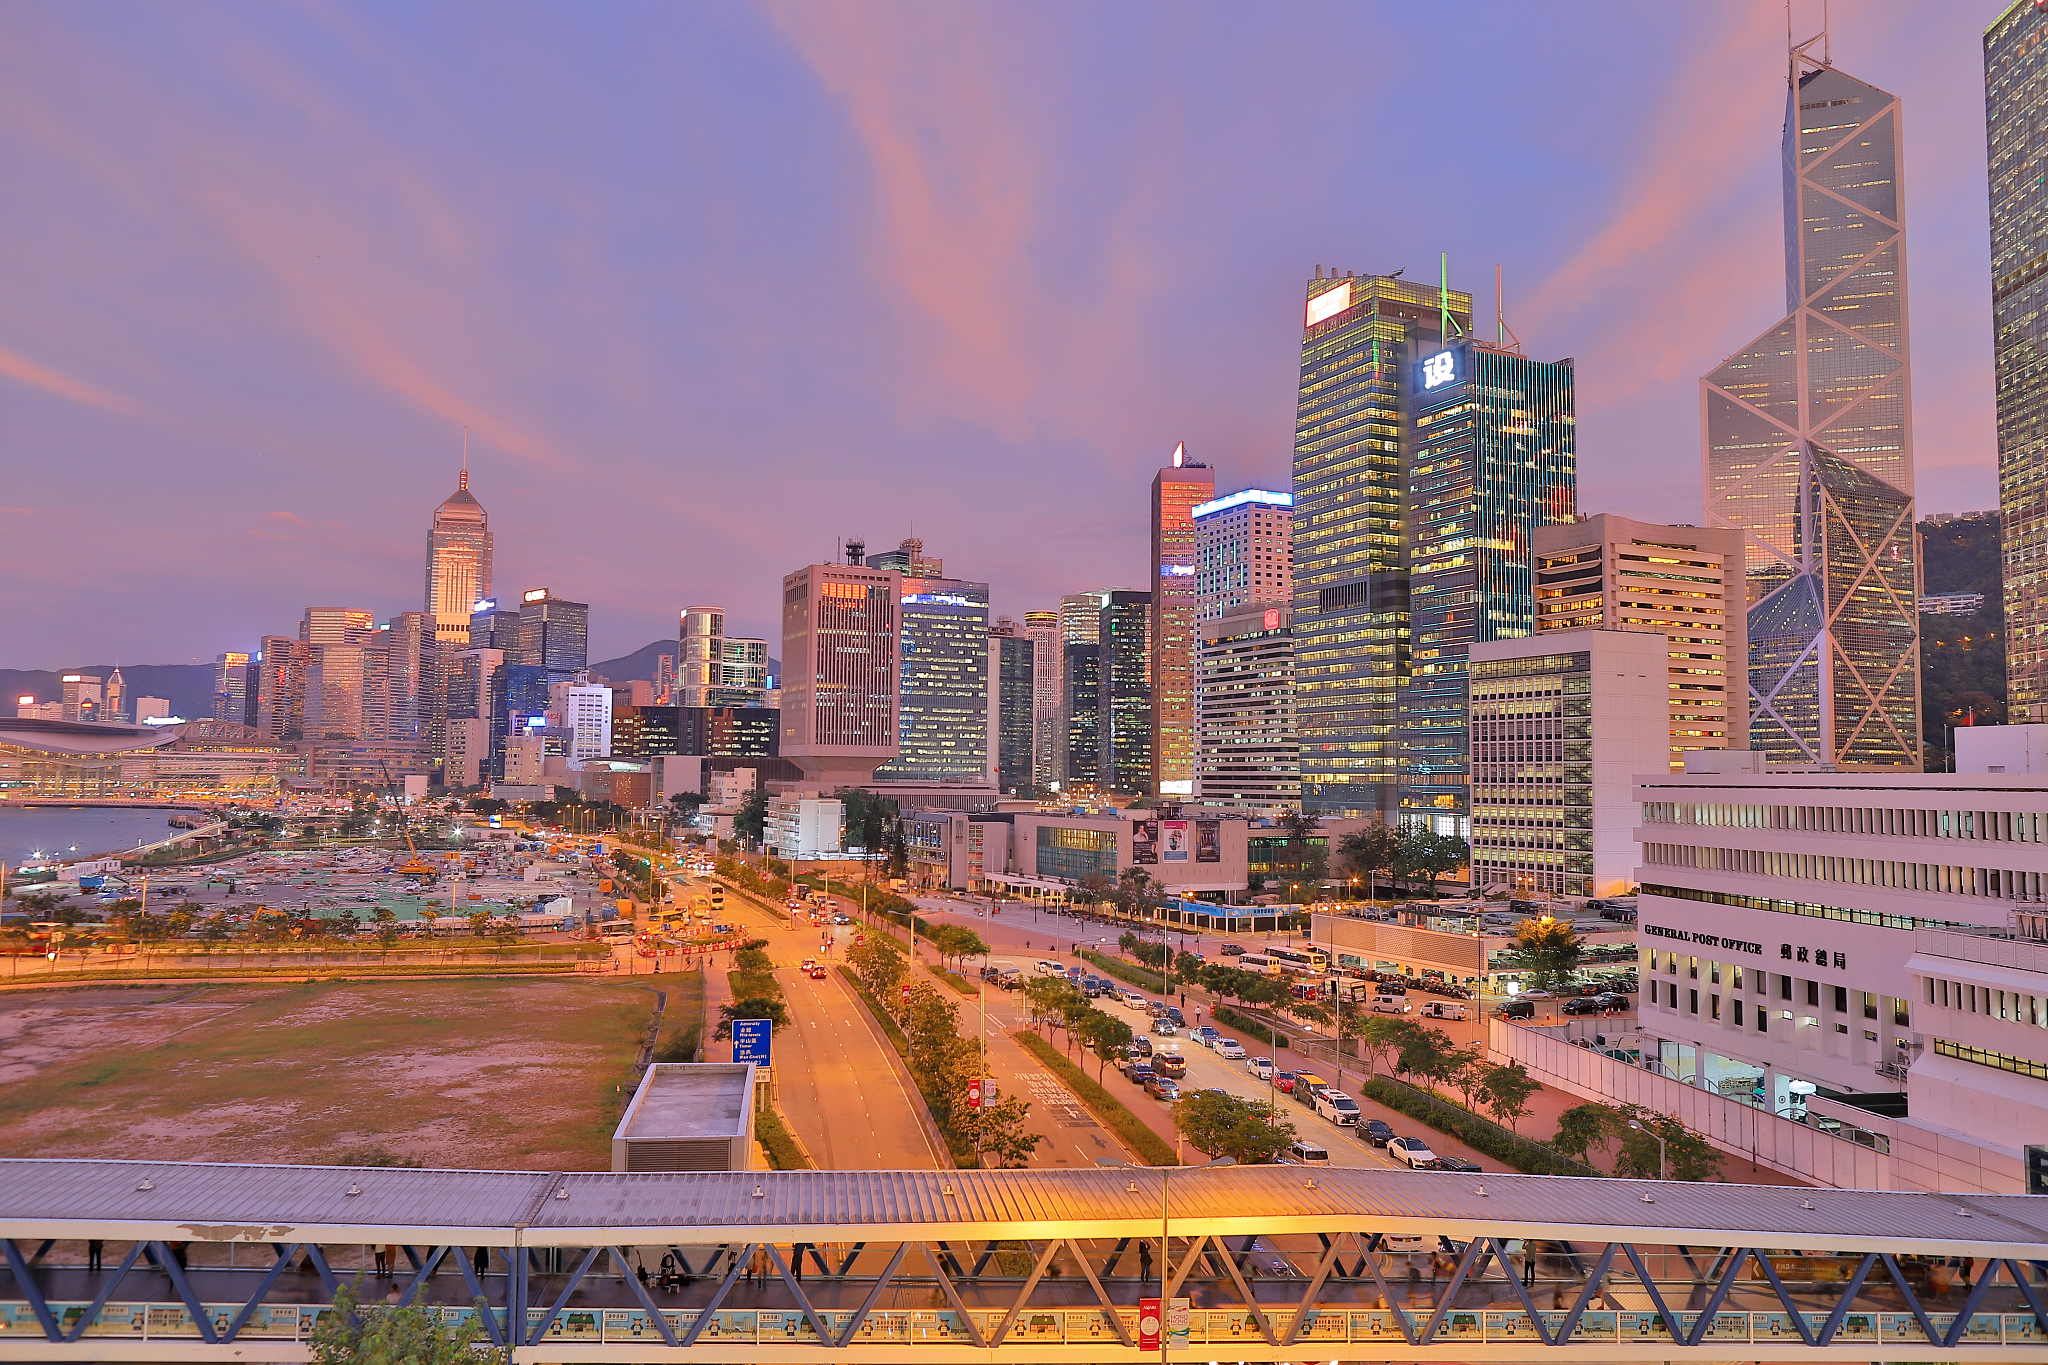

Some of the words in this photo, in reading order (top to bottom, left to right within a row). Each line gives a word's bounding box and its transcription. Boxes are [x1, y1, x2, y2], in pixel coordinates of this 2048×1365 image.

[1644, 924, 1690, 942] GENERAL
[1692, 932, 1719, 947] POST
[1721, 937, 1762, 955] OFFICE
[1780, 943, 1846, 970] 郵政總局
